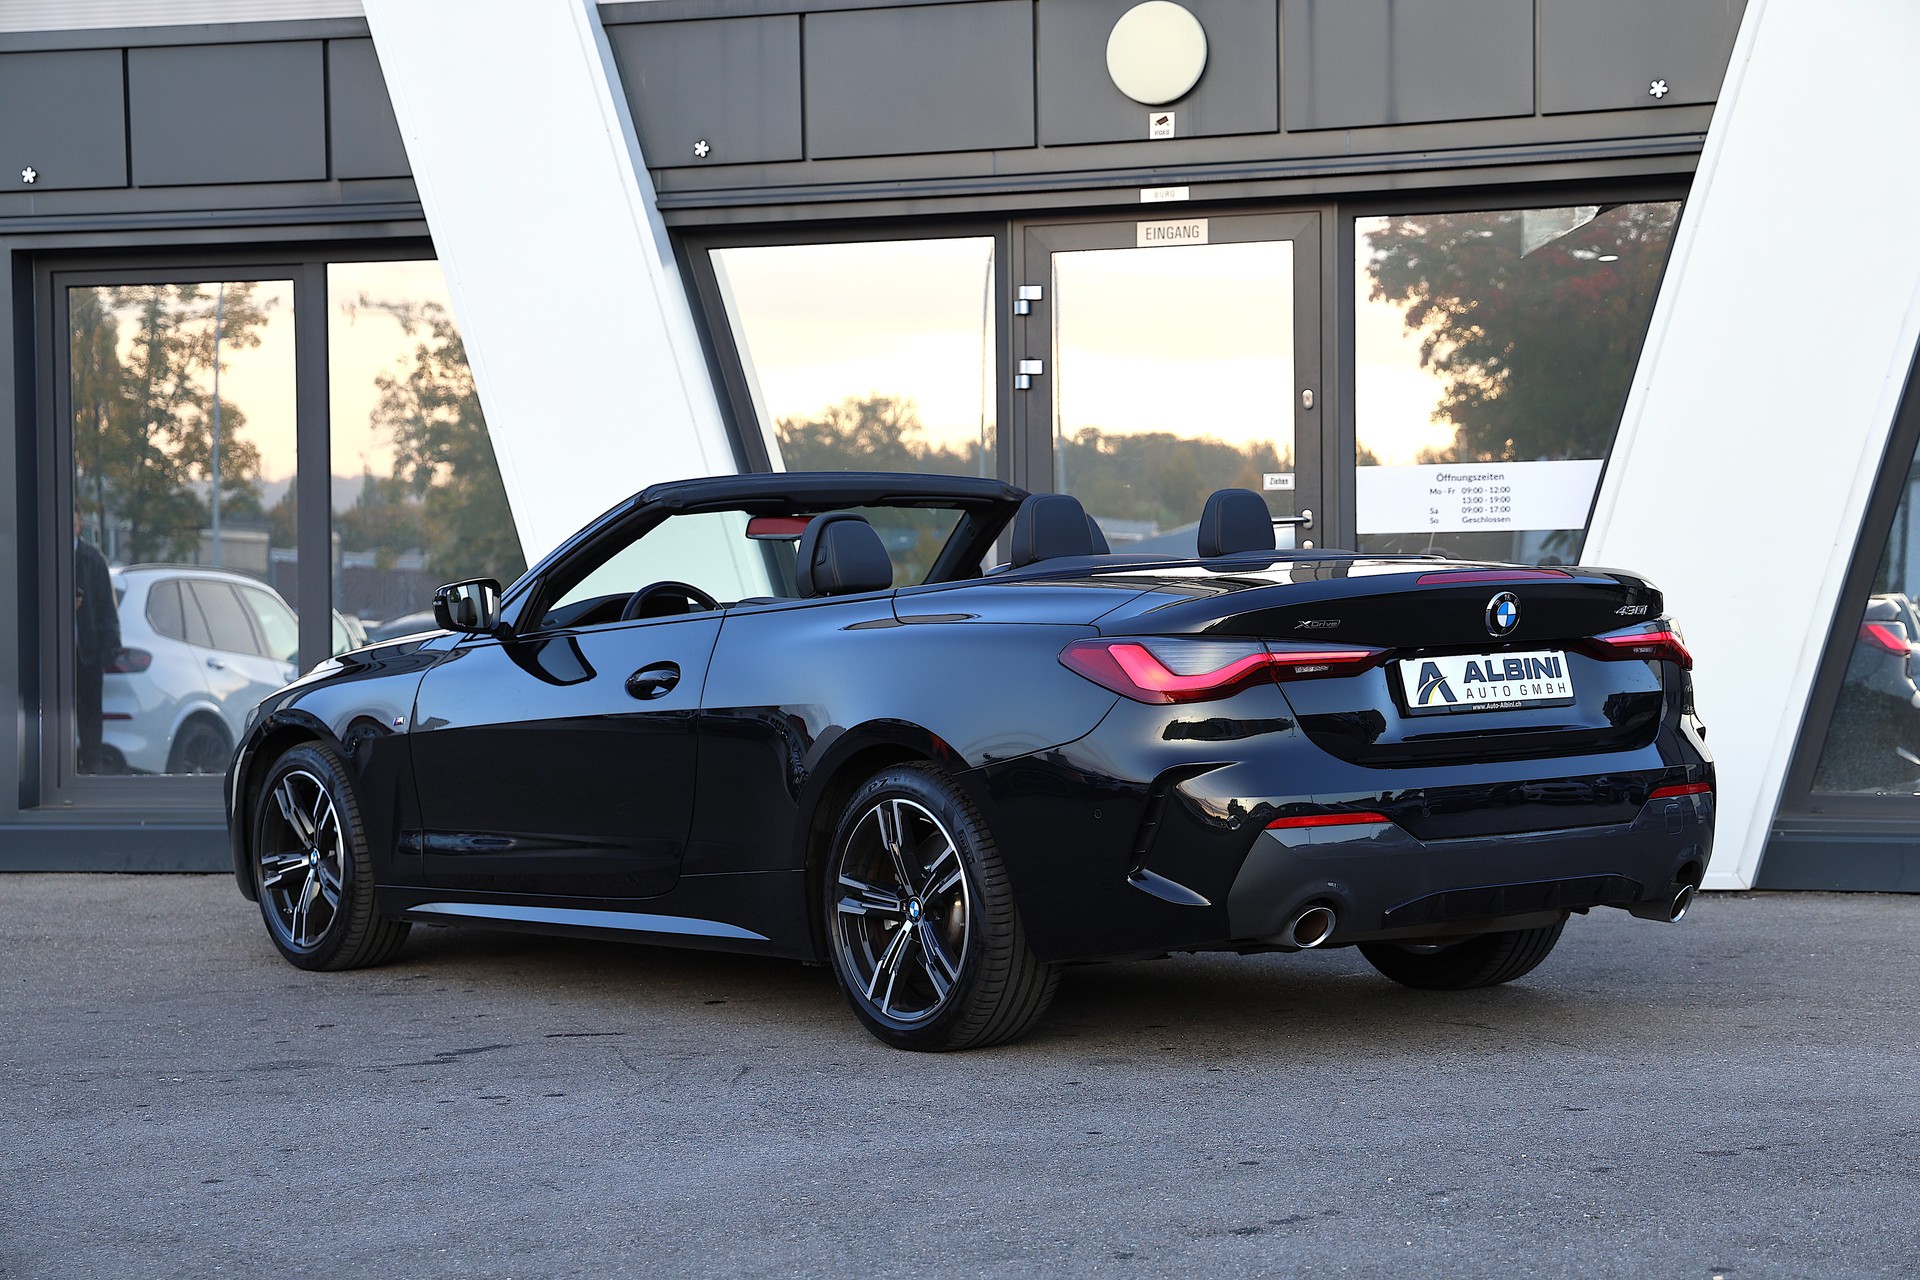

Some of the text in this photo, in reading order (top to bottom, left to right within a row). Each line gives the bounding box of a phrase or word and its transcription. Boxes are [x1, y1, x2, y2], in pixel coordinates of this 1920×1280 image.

[1145, 224, 1200, 241] EINGANG
[1436, 472, 1505, 483] Öffnungszeiten
[1461, 486, 1484, 494] 09:00
[1489, 486, 1511, 494] 12:00
[1489, 495, 1511, 503] 19:00
[1429, 507, 1439, 515] Sa
[1461, 506, 1484, 514] 09:00
[1489, 505, 1511, 513] 17:00
[1429, 516, 1511, 524] So Geschlossen
[1614, 604, 1648, 616] 430i
[1463, 656, 1563, 684] ALBINI
[1466, 682, 1567, 700] AUTO GMBH
[1472, 701, 1523, 711] www.Auto-Albini.ch
